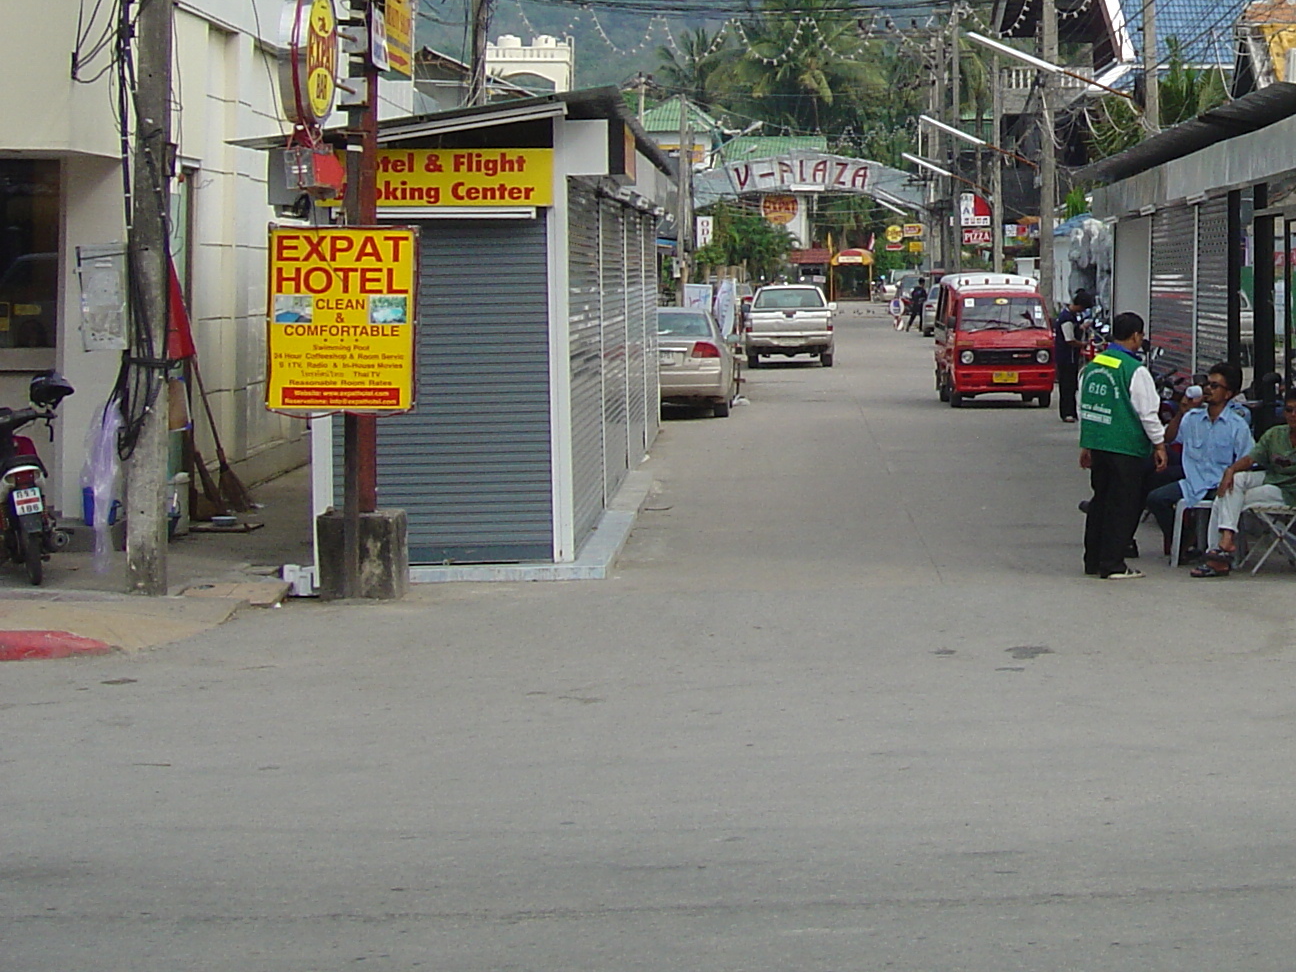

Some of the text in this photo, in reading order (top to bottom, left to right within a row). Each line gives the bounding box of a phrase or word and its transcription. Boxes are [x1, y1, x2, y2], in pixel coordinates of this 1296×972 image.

[308, 31, 337, 77] EXPAT
[315, 72, 328, 100] BAR
[424, 154, 444, 173] &
[453, 152, 526, 177] Flight
[451, 182, 535, 201] Center
[964, 231, 990, 242] PIZZA
[276, 234, 409, 263] EXPAT
[276, 266, 409, 294] HOTEL
[315, 298, 365, 310] CLEAN
[335, 312, 345, 323] &
[284, 324, 400, 337] COMFORTABLE
[313, 344, 351, 352] Swimming
[1088, 382, 1107, 396] 616
